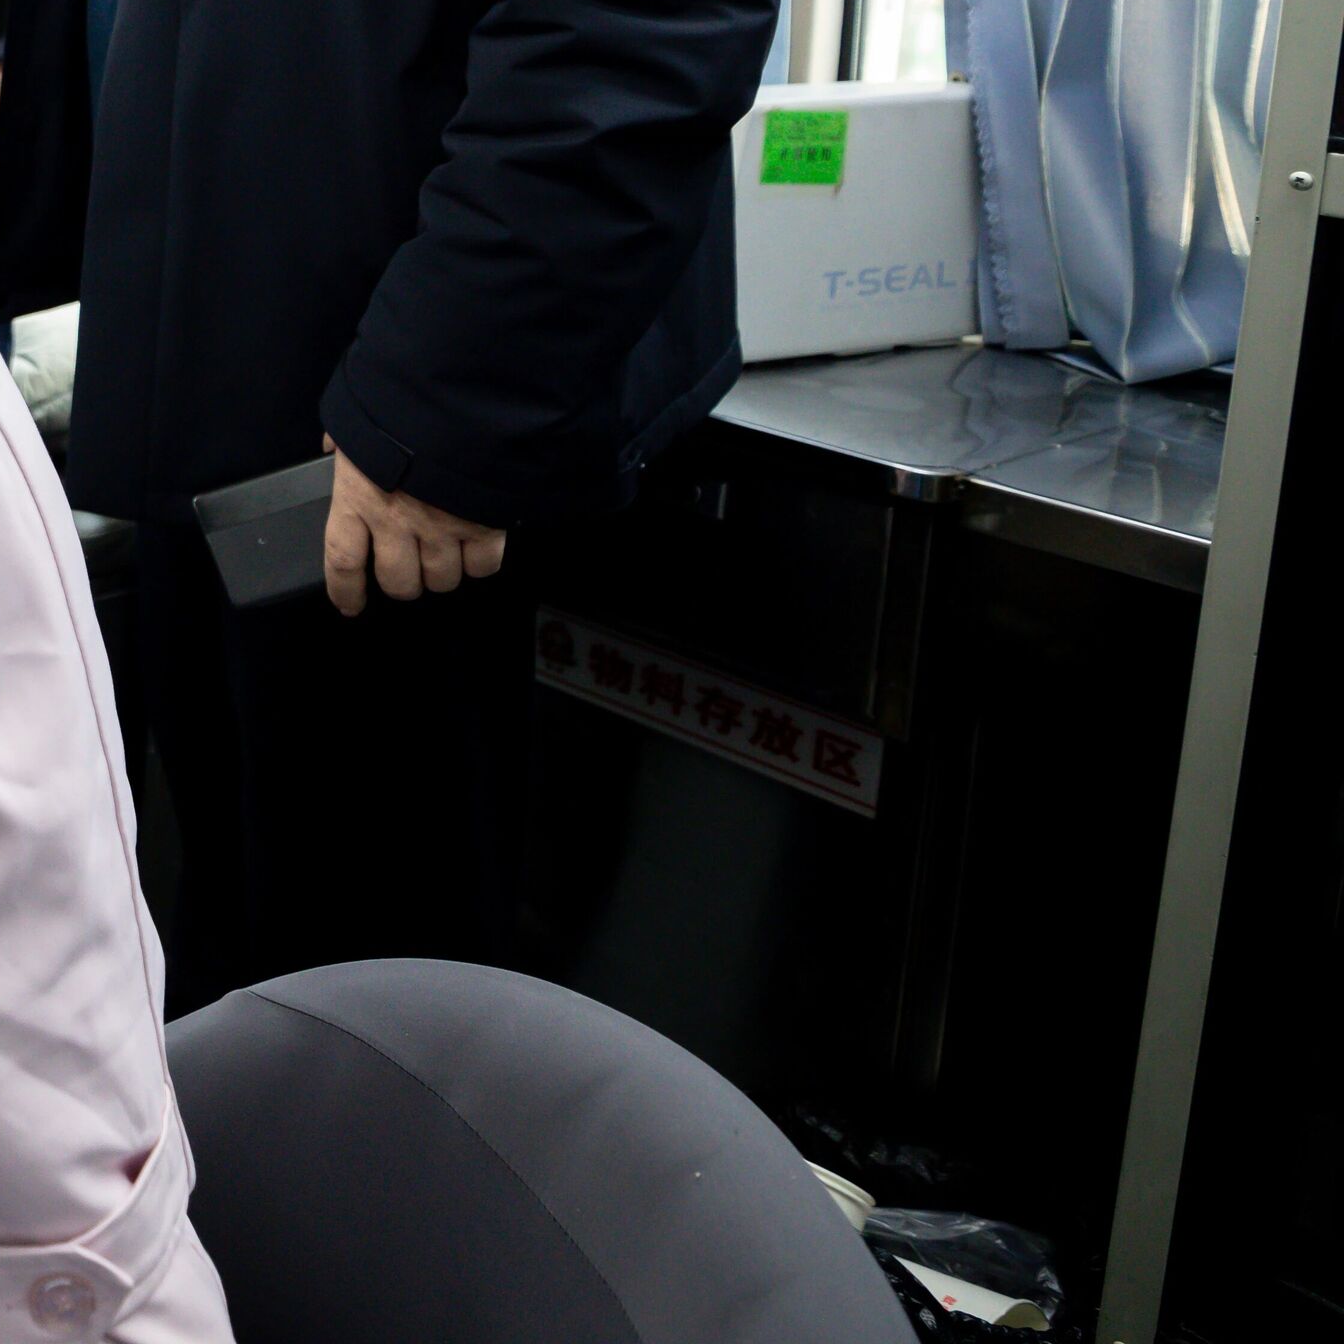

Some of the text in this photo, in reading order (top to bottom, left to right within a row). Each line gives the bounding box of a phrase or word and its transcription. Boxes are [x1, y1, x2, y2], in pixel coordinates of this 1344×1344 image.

[823, 259, 958, 299] T-SEAL
[588, 642, 863, 787] 物料存放区
